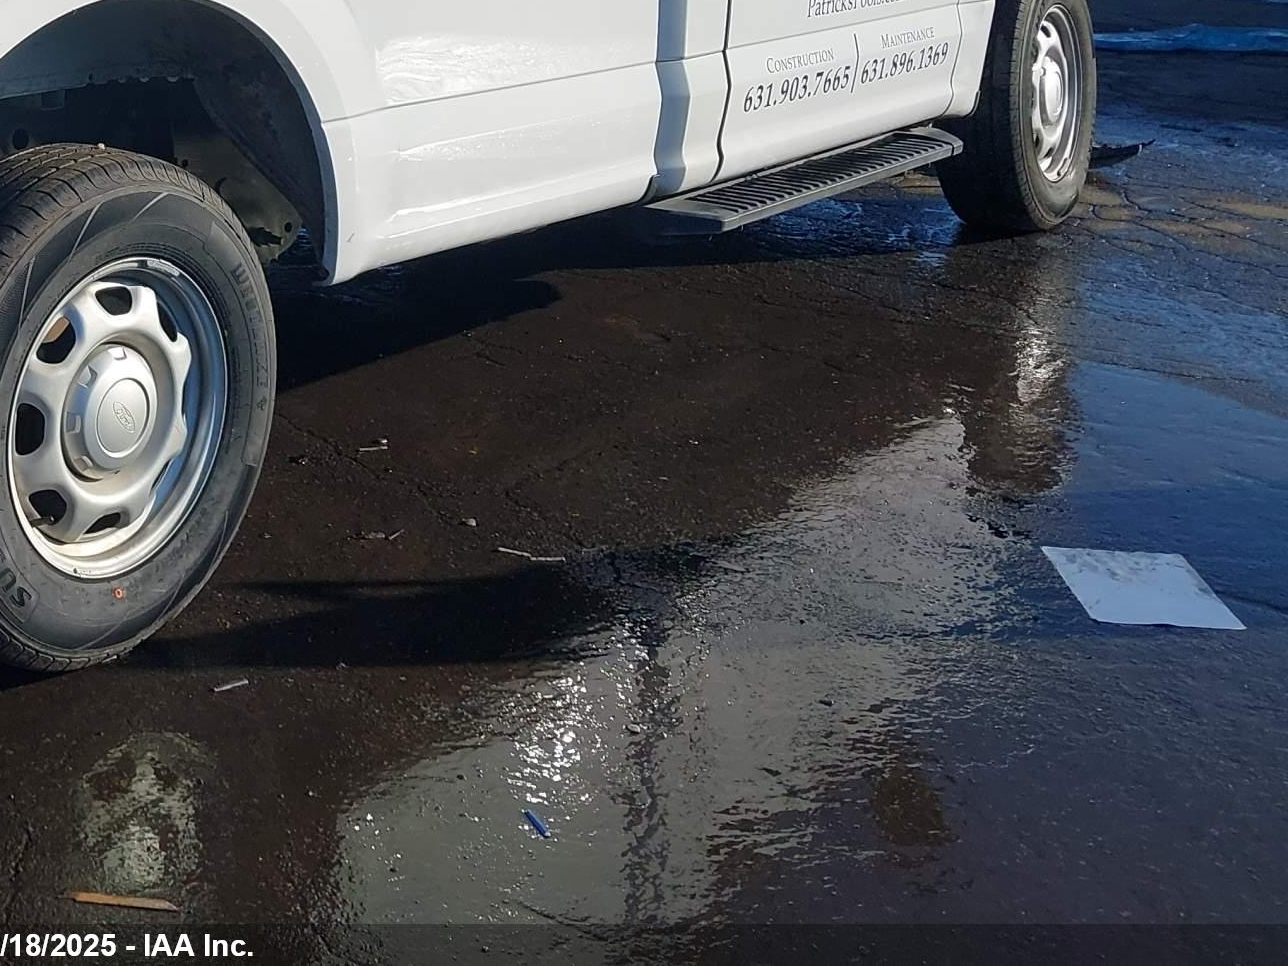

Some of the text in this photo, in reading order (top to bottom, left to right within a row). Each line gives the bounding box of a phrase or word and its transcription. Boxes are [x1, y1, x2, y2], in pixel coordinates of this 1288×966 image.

[880, 26, 935, 49] MAINTENANCE
[766, 47, 835, 74] CONSTRUCTION
[743, 42, 949, 114] 631.903.7665 631.896.1369
